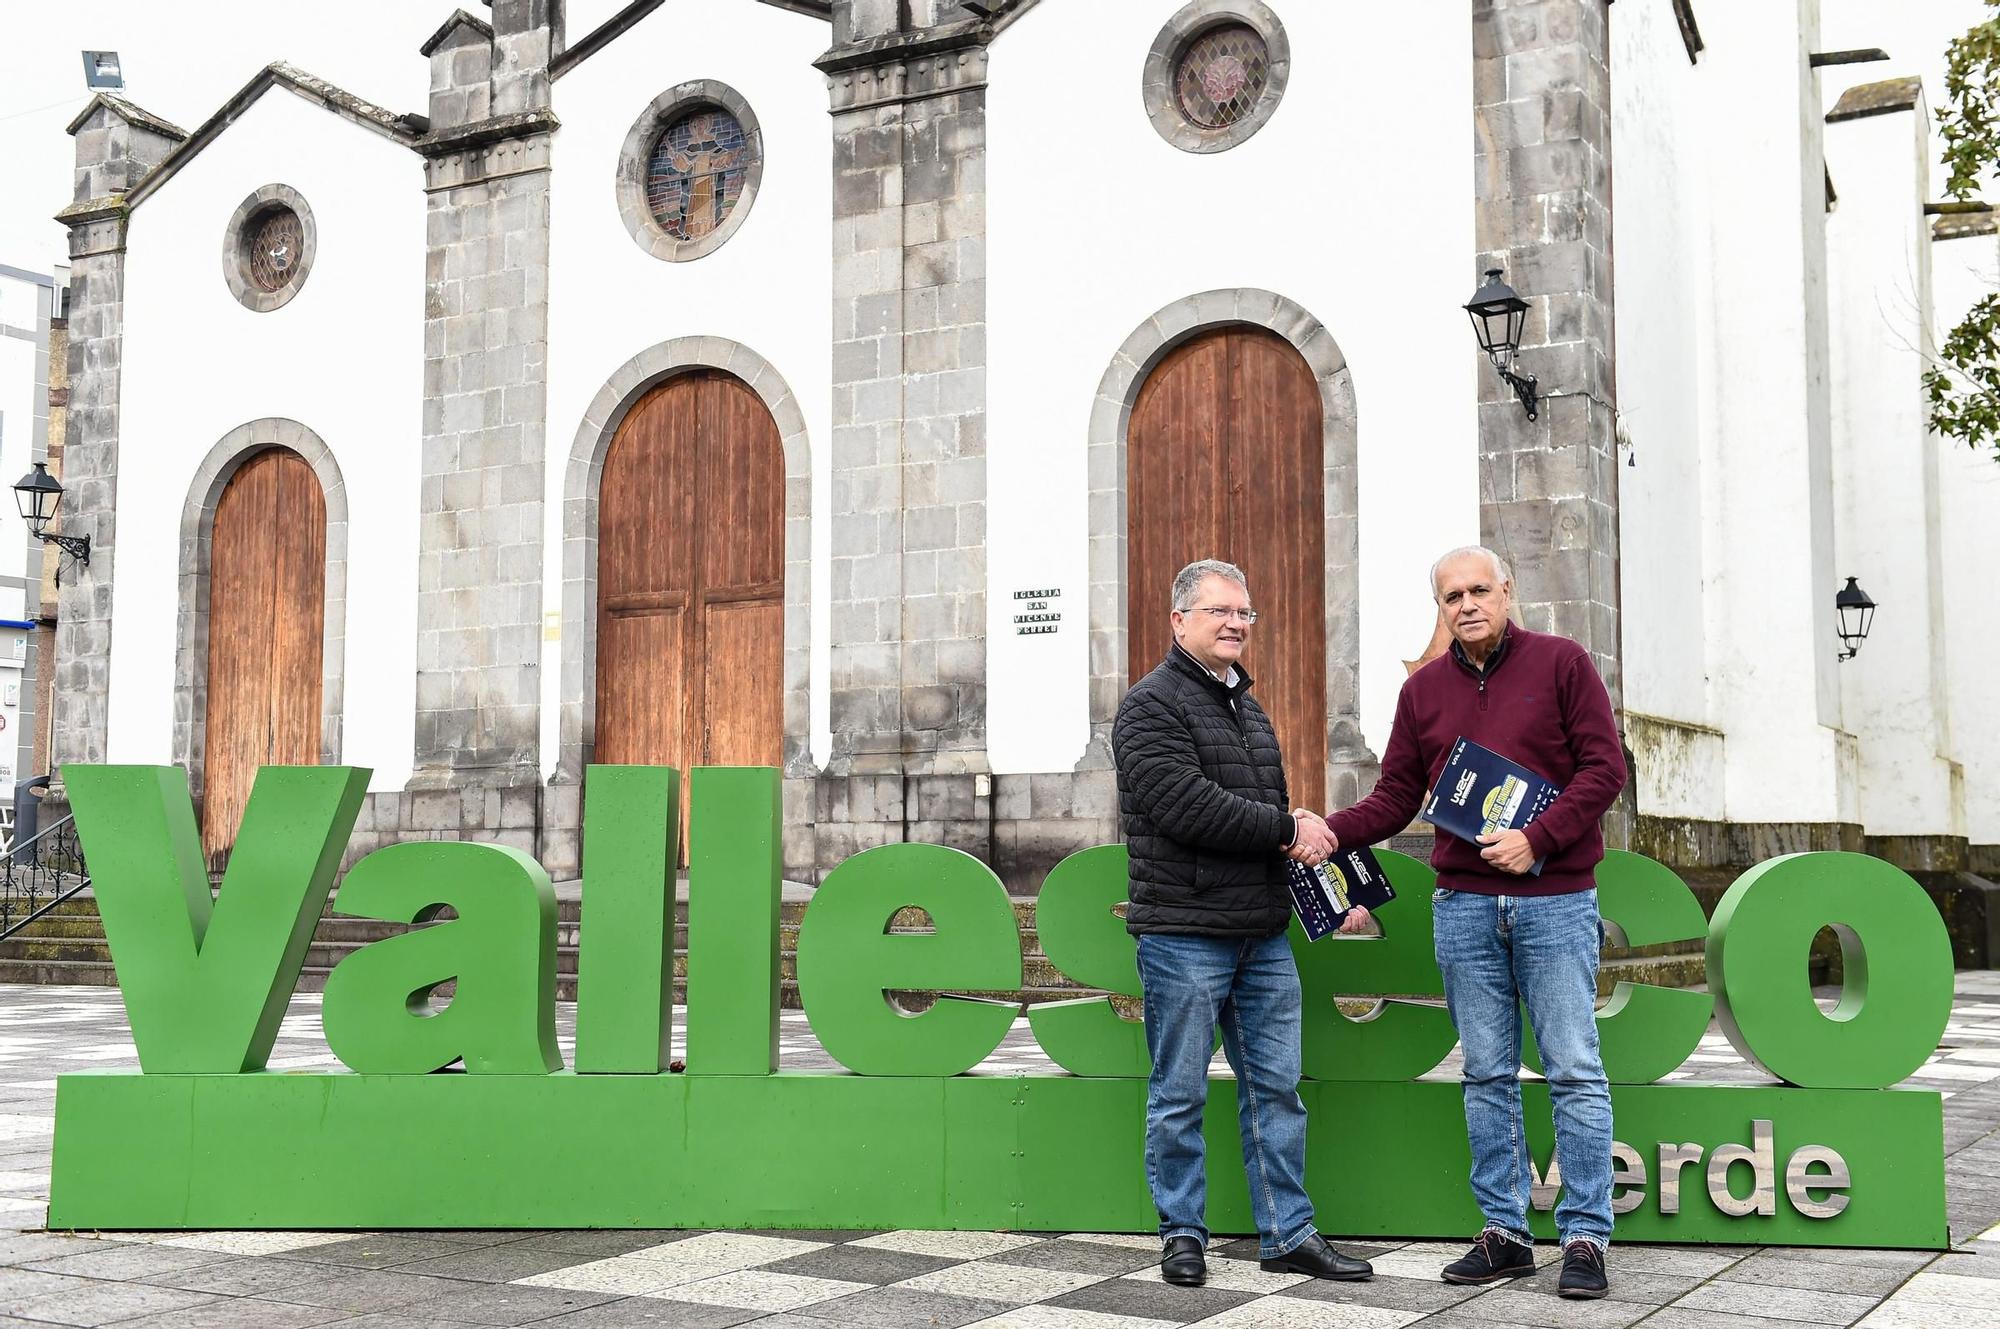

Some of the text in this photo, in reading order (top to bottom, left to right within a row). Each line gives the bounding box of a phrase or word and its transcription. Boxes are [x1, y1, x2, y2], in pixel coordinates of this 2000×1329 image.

[1013, 589, 1061, 600] IGLESIA
[1027, 602, 1047, 610] SAN
[1013, 613, 1061, 623] VICENTE
[1017, 625, 1058, 635] FERRER
[1487, 802, 1503, 822] ISLAS
[1322, 864, 1337, 882] ISLAS
[1330, 879, 1352, 910] CANARIAS
[61, 764, 1955, 1089] Valleseco
